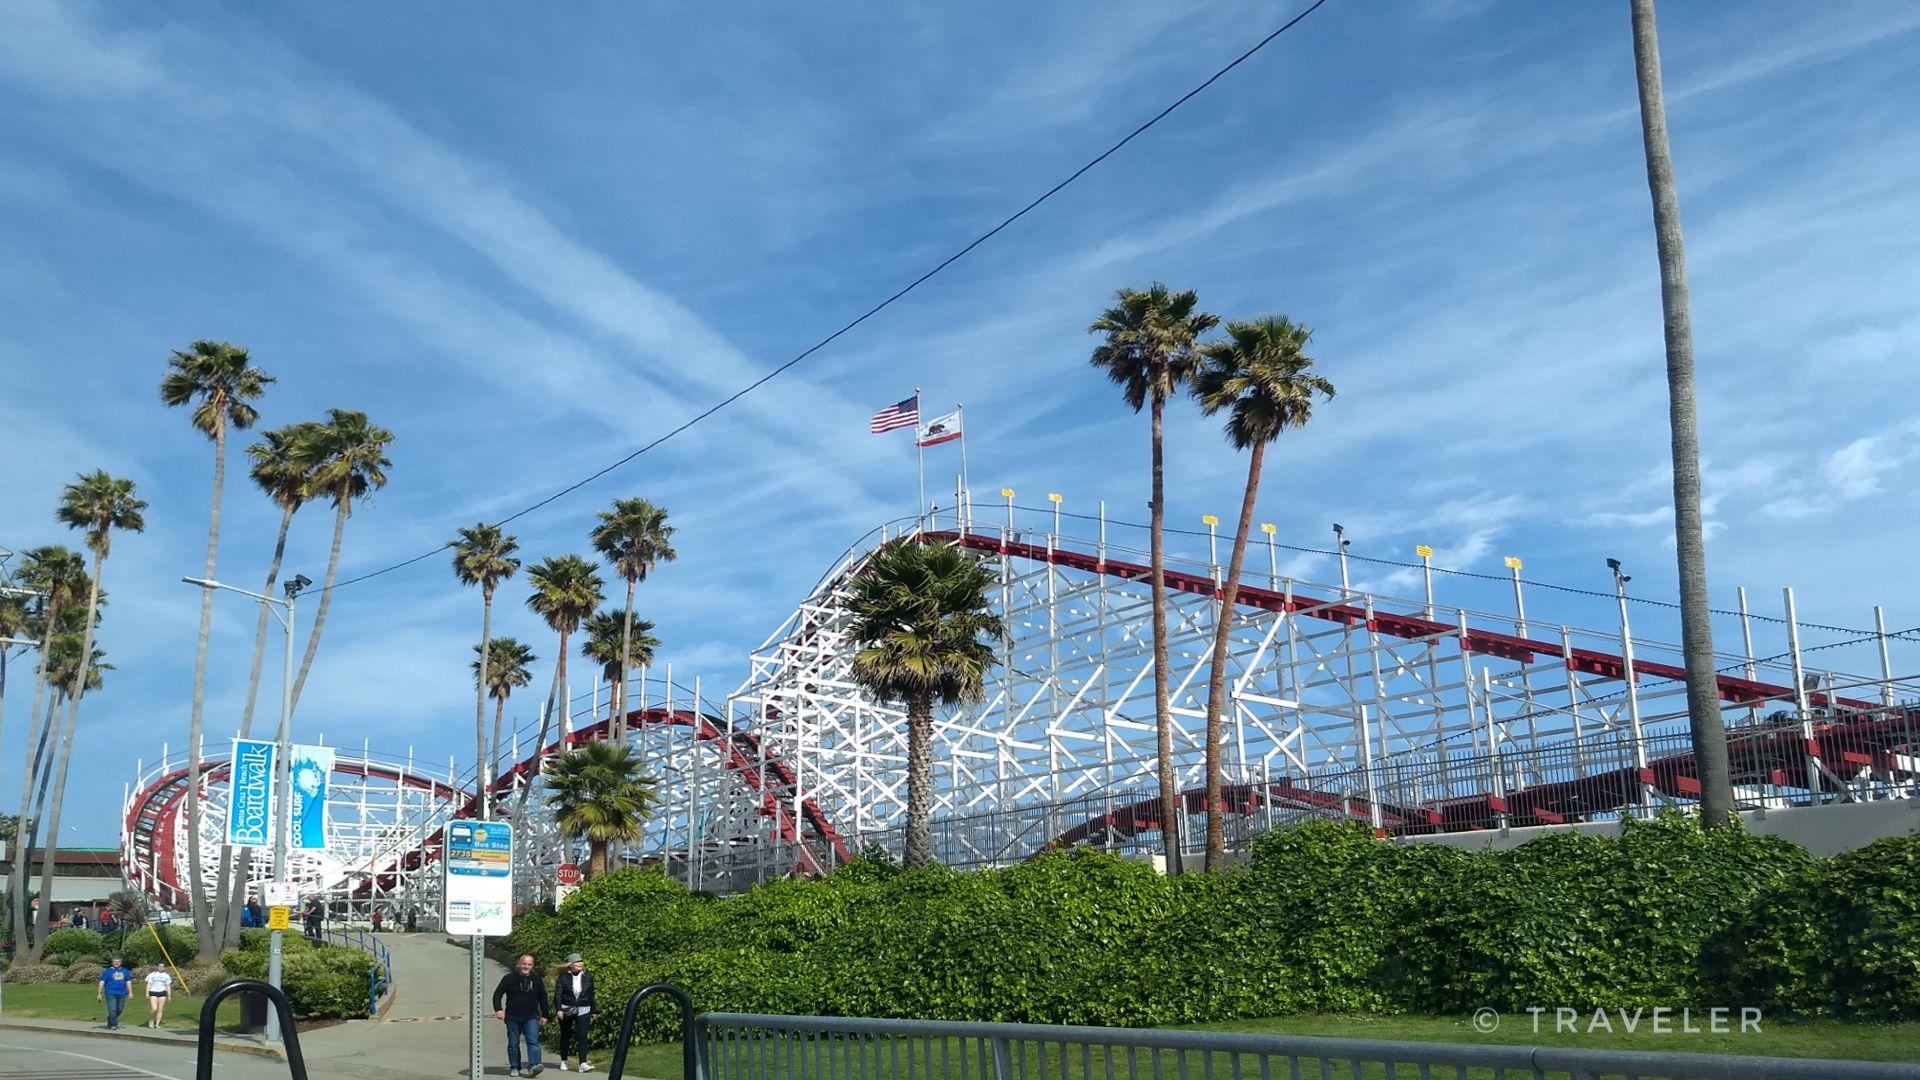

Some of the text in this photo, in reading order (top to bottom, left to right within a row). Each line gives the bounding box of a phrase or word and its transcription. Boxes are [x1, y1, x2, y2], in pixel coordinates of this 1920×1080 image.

[236, 745, 268, 844] Boardwalk
[237, 764, 248, 829] Santa Cruz Beach
[293, 792, 304, 847] COOL SURF
[491, 842, 510, 850] Stop
[558, 869, 580, 878] STOP
